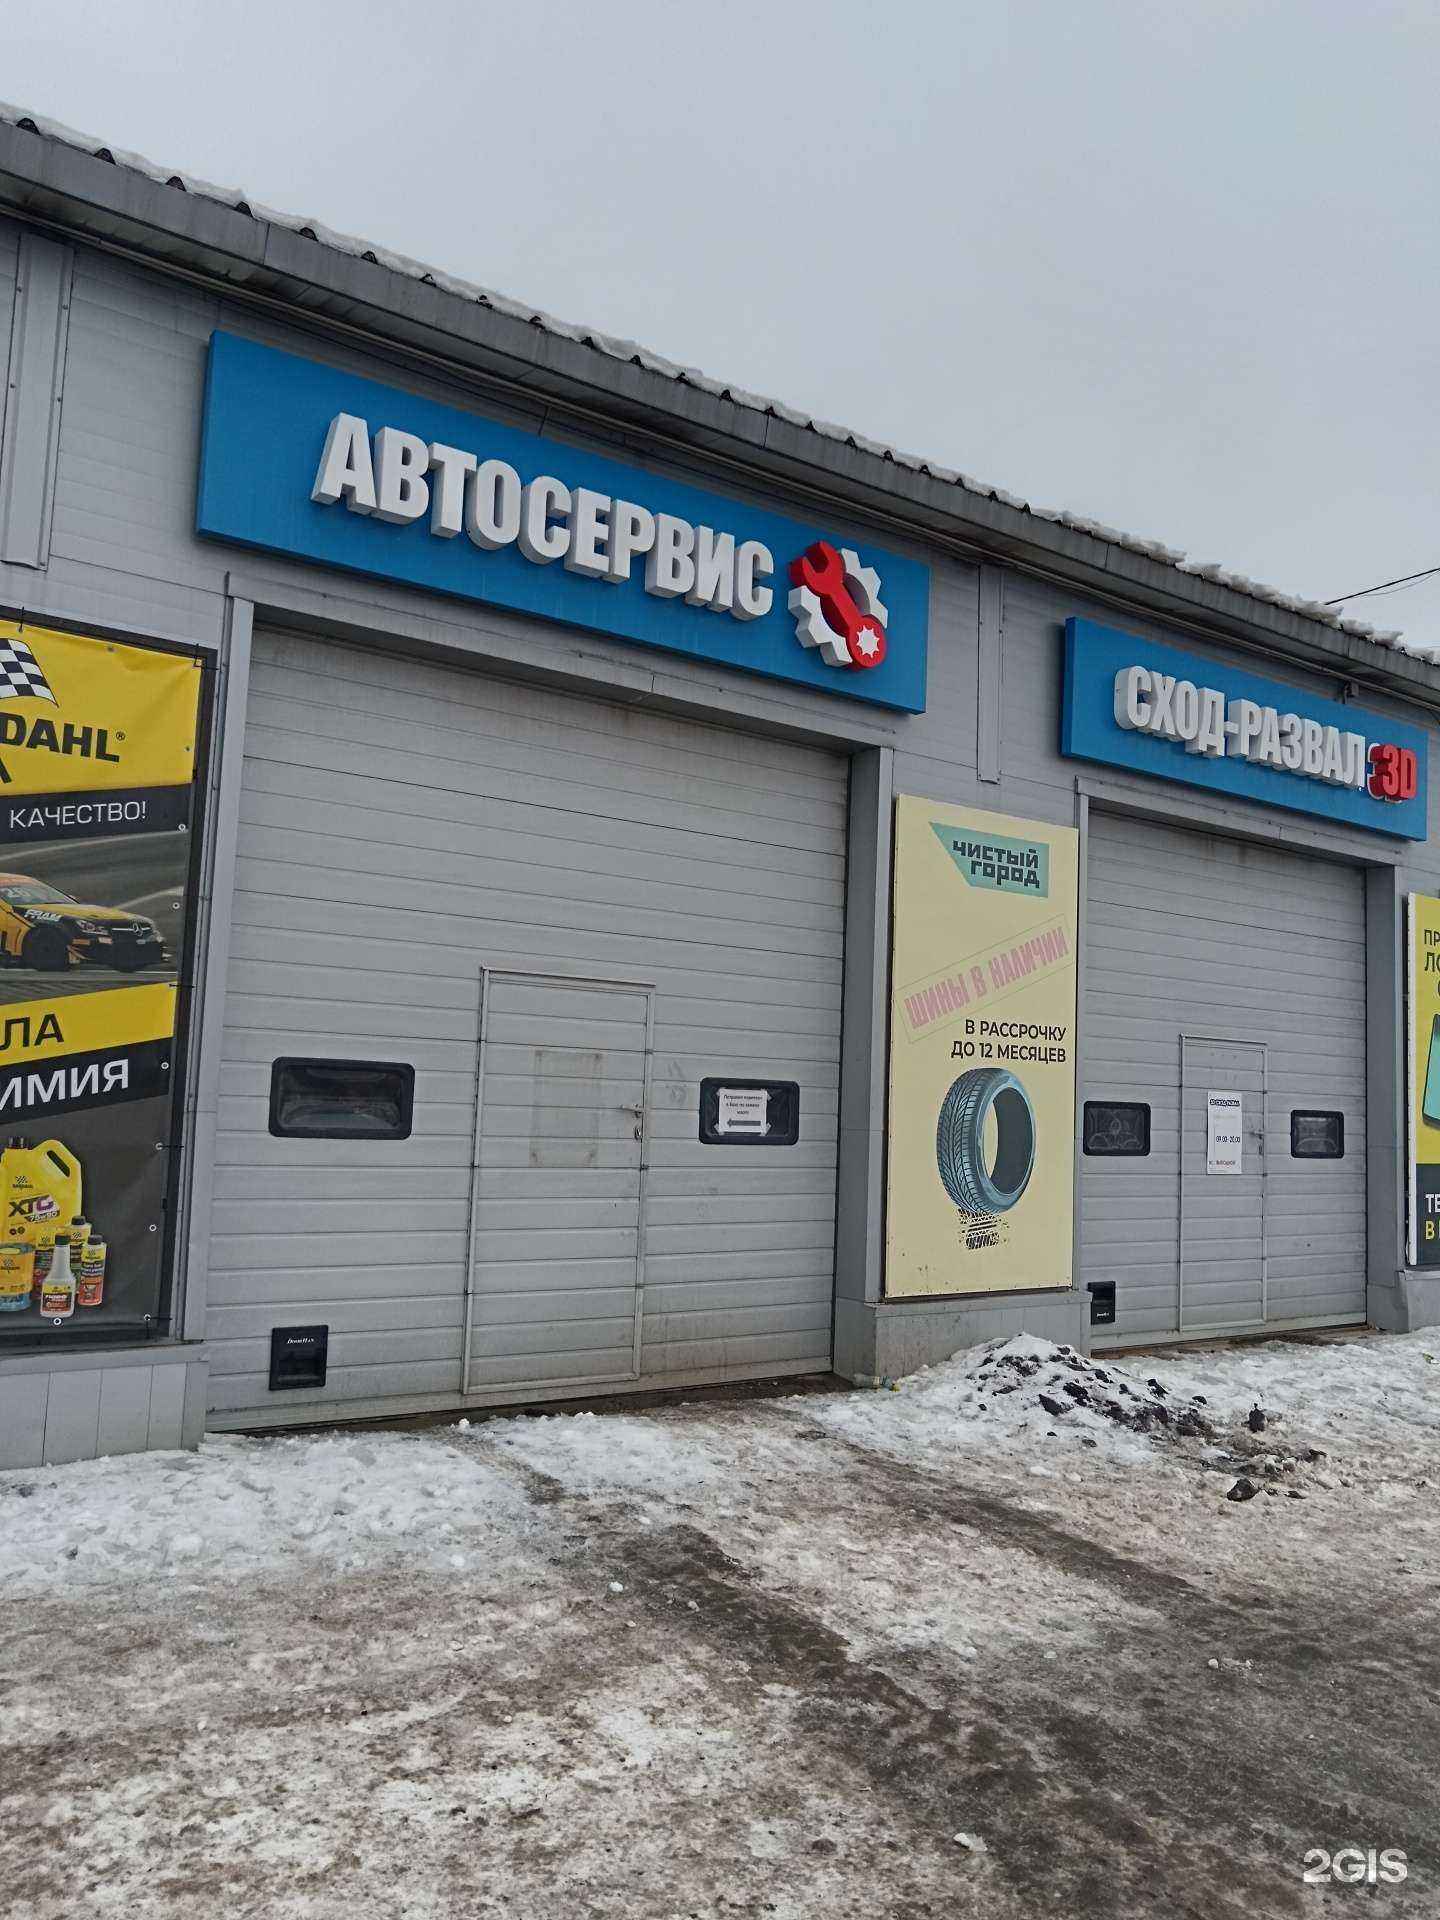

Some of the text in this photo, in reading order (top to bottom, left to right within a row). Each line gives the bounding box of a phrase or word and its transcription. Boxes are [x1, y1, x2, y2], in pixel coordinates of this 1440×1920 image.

[310, 411, 775, 622] АВТОСЕРВИС
[1113, 665, 1418, 803] СХОД-РАЗВАЛ 3D
[9, 800, 147, 829] КАЧЕСТВО!
[904, 925, 1070, 1030] ШИНЫ В НАЛИЧИИ
[965, 1019, 1067, 1042] В РАССРОЧКУ
[951, 1040, 1067, 1065] ДО 12 МЕСЯЦЕВ
[8, 1194, 55, 1218] XTC
